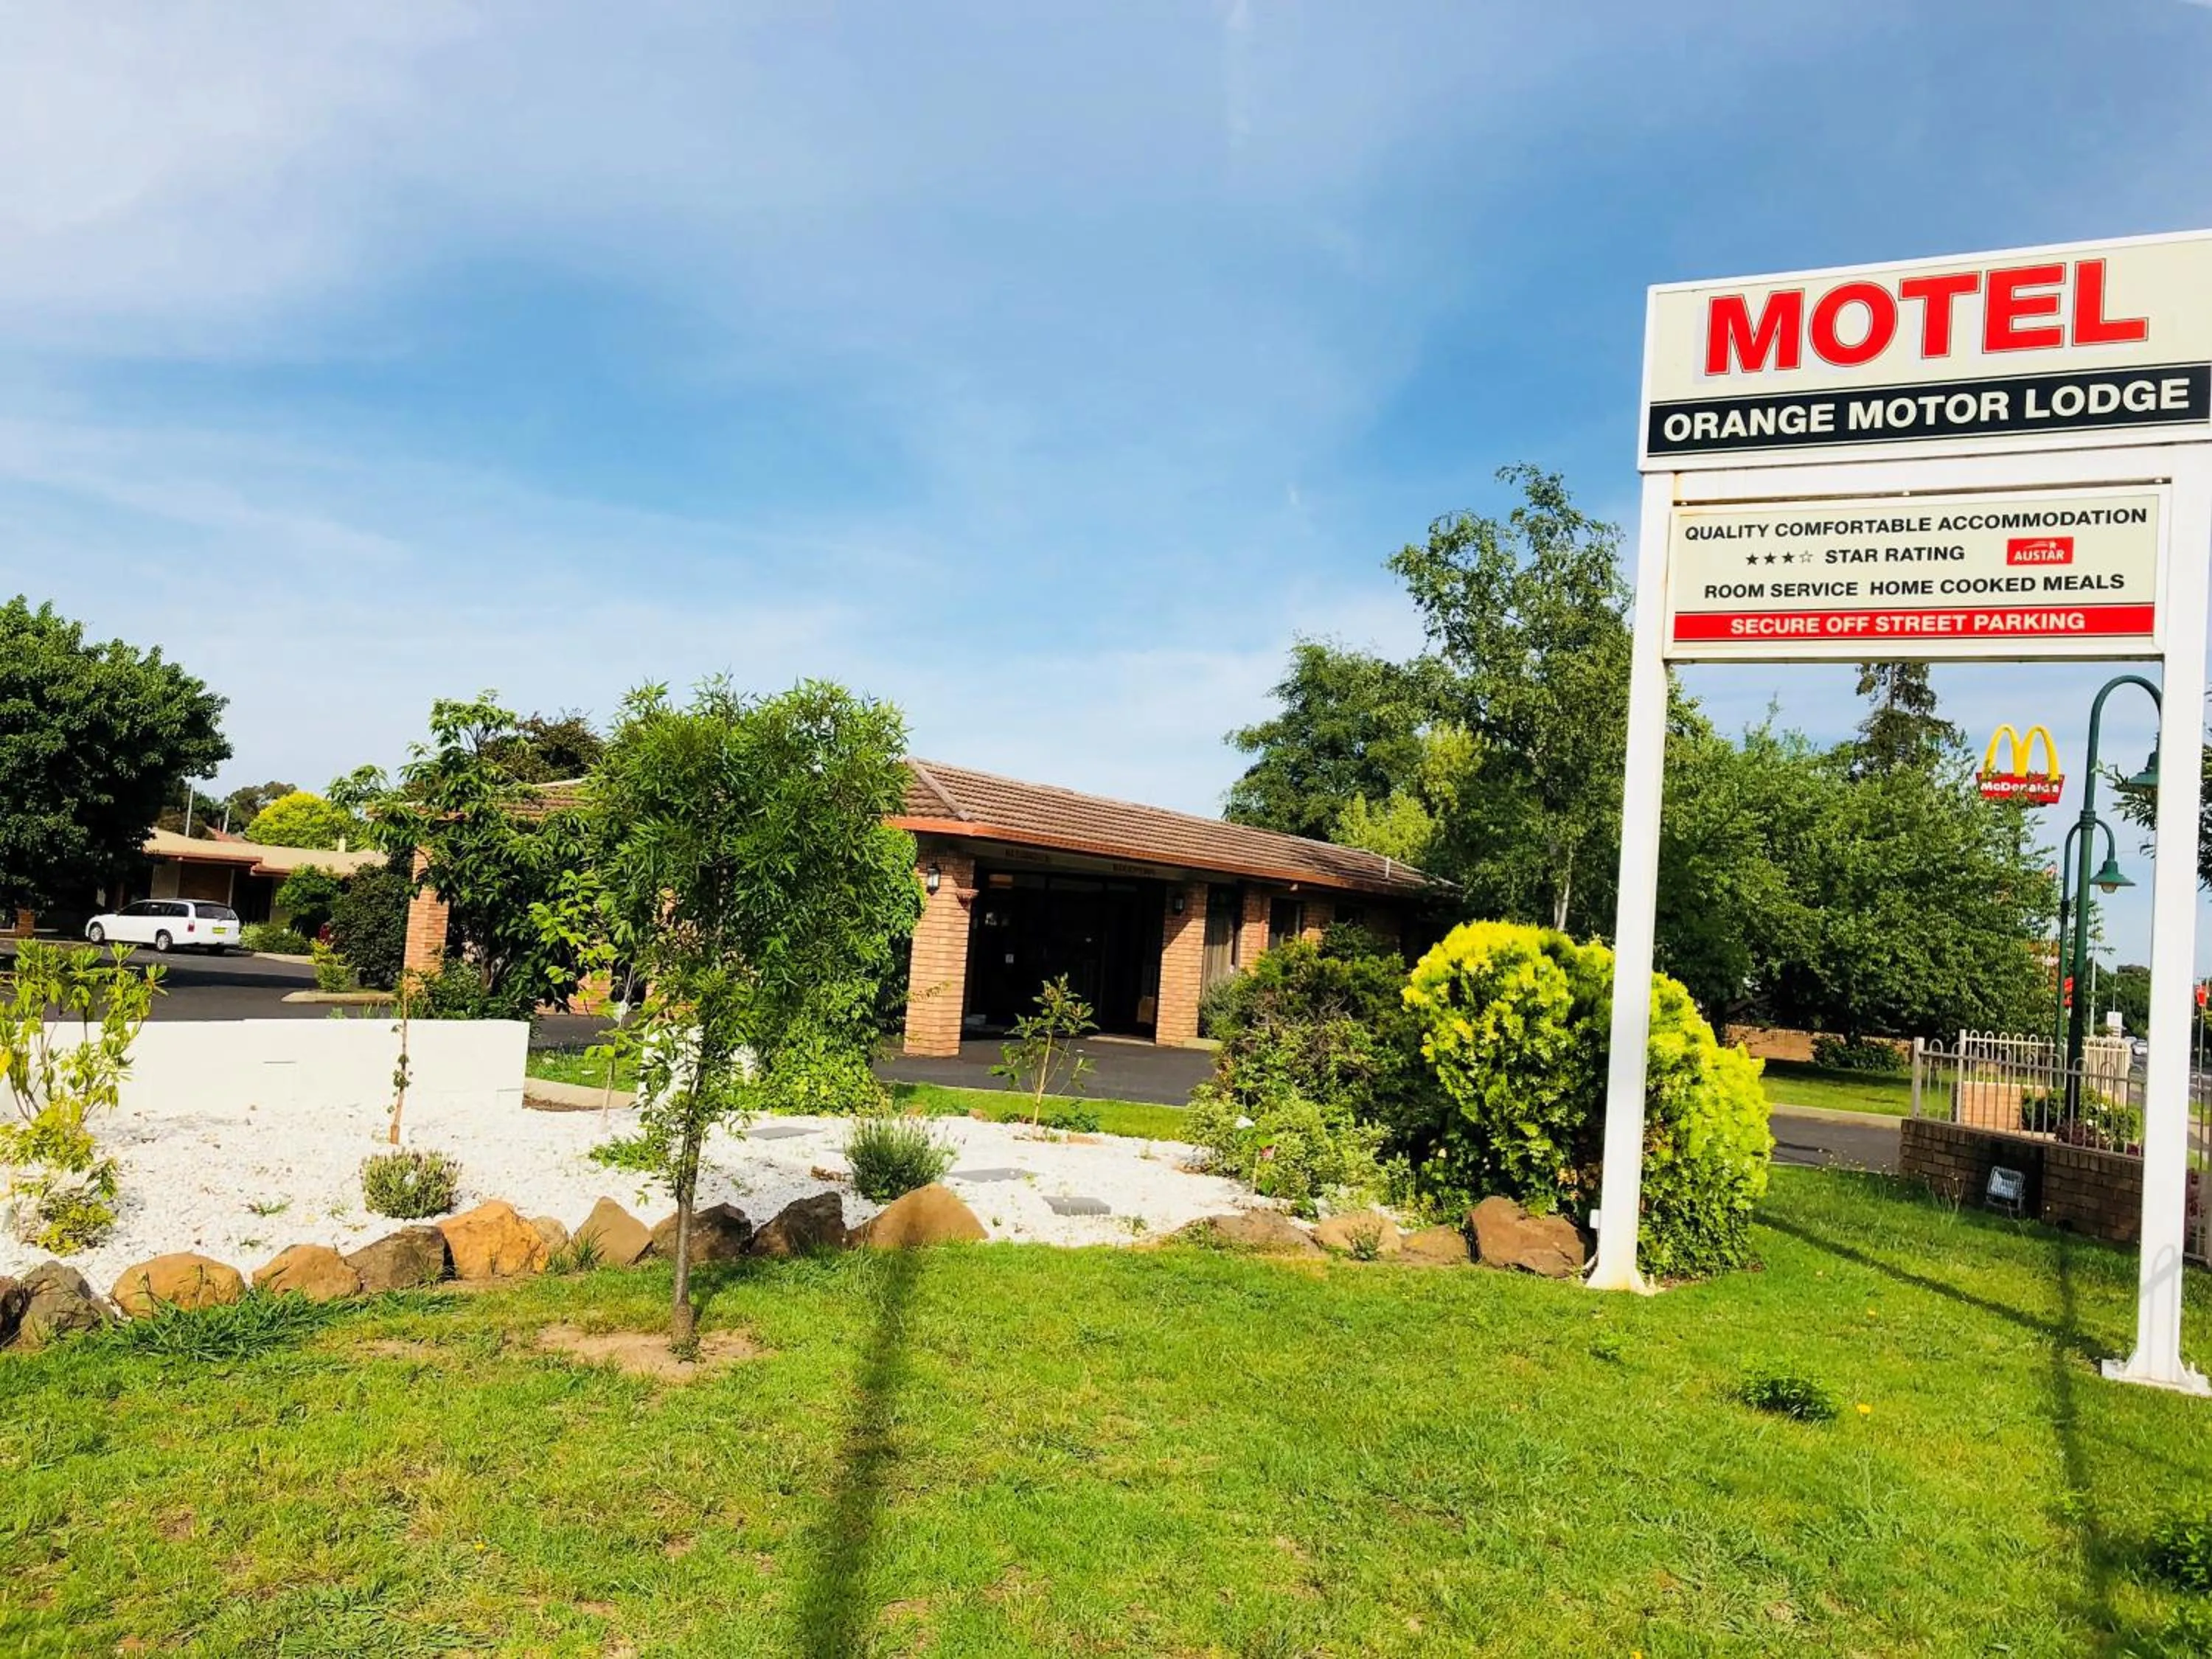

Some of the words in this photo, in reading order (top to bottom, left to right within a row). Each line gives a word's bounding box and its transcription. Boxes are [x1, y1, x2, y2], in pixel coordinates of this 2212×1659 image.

[1705, 258, 2149, 376] MOTEL
[1663, 403, 1835, 442] ORANGE
[1848, 391, 2009, 431] MOTOR
[2025, 378, 2190, 419] LODGE
[1685, 524, 1769, 540] QUALITY
[1775, 517, 1932, 538] COMFORTABLE
[1938, 508, 2147, 531] ACCOMMODATION
[1825, 548, 1878, 564] STAR
[1885, 546, 1965, 562] RATING
[2014, 549, 2065, 562] AUSTAR
[1704, 583, 1764, 599] ROOM
[1770, 582, 1859, 598] SERVICE
[1870, 580, 1934, 596] HOME
[1940, 577, 2036, 594] COOKED
[2043, 574, 2124, 591] MEALS
[1731, 617, 1820, 634] SECURE
[1826, 616, 1869, 633] OFF
[1875, 615, 1966, 632] STREET
[1974, 613, 2084, 630] PARKING
[1980, 782, 2059, 793] McDonalds
